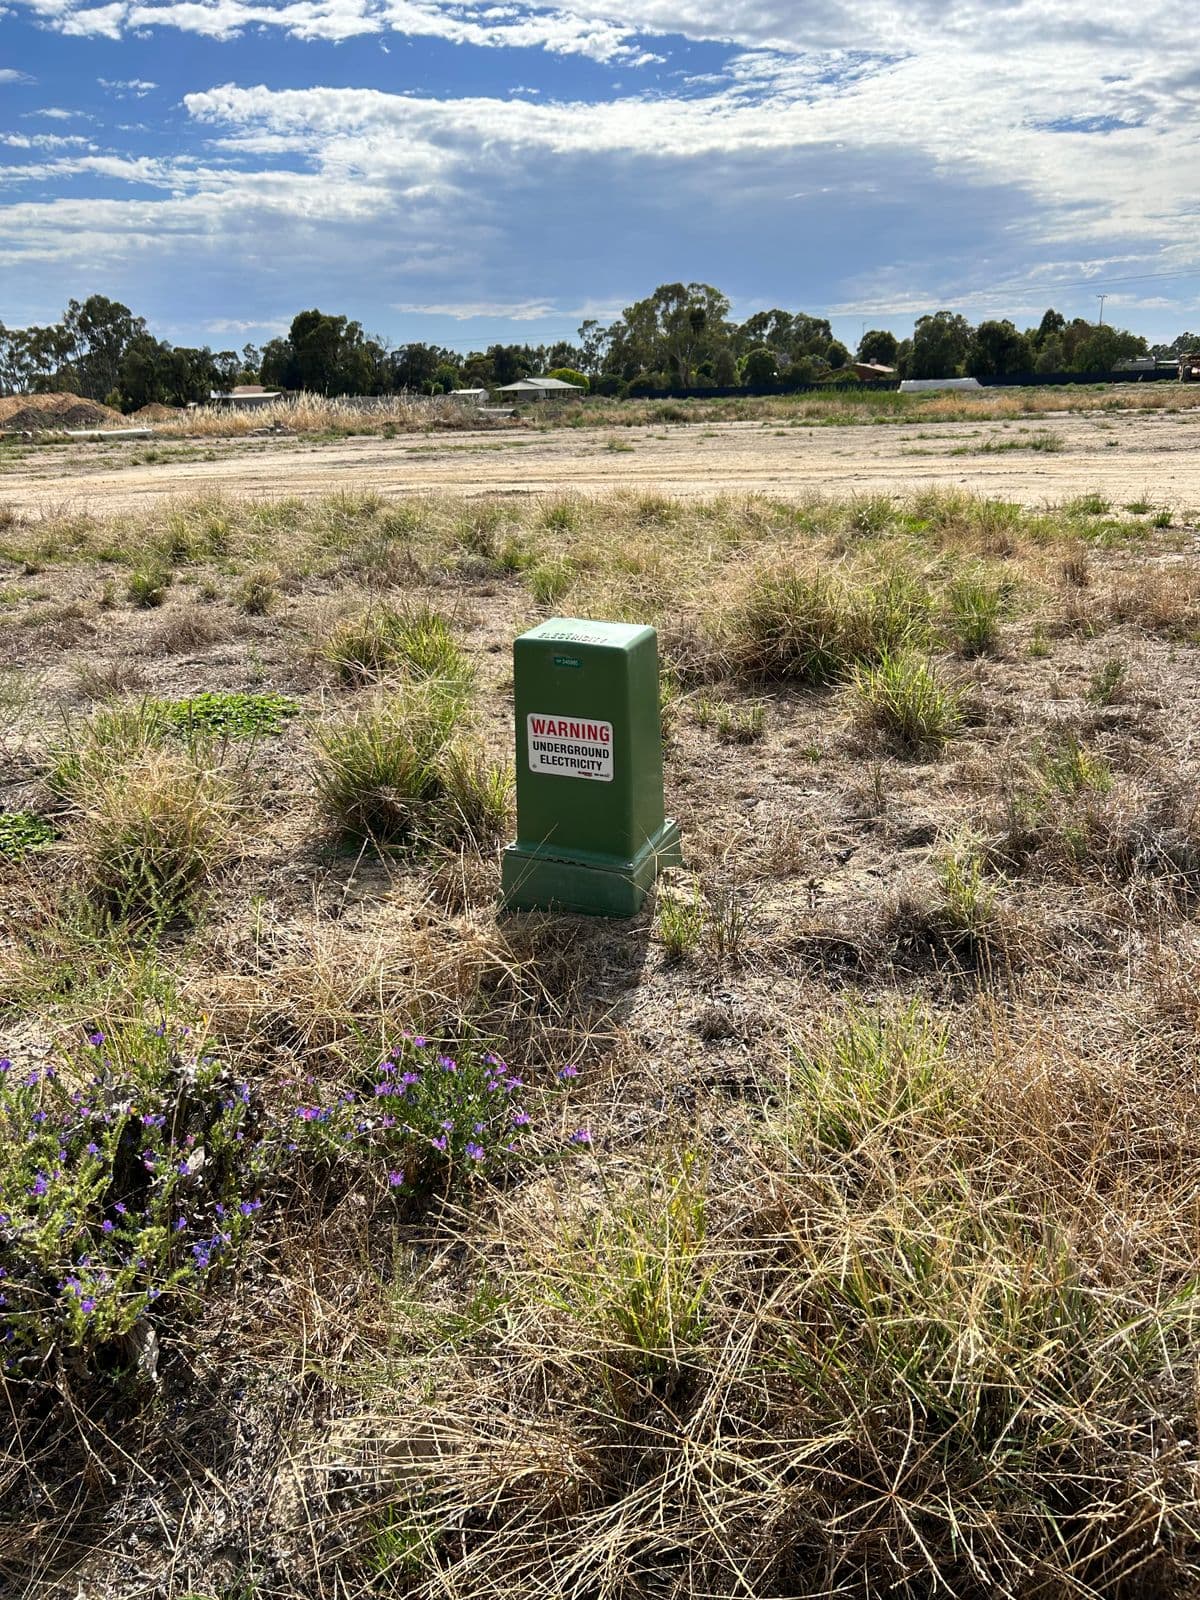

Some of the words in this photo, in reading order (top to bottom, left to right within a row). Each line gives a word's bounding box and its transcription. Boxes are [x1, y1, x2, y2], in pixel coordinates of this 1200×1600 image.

[531, 718, 610, 742] WARNING
[532, 740, 610, 759] UNDERGROUND
[540, 754, 603, 771] ELECTRICITY
